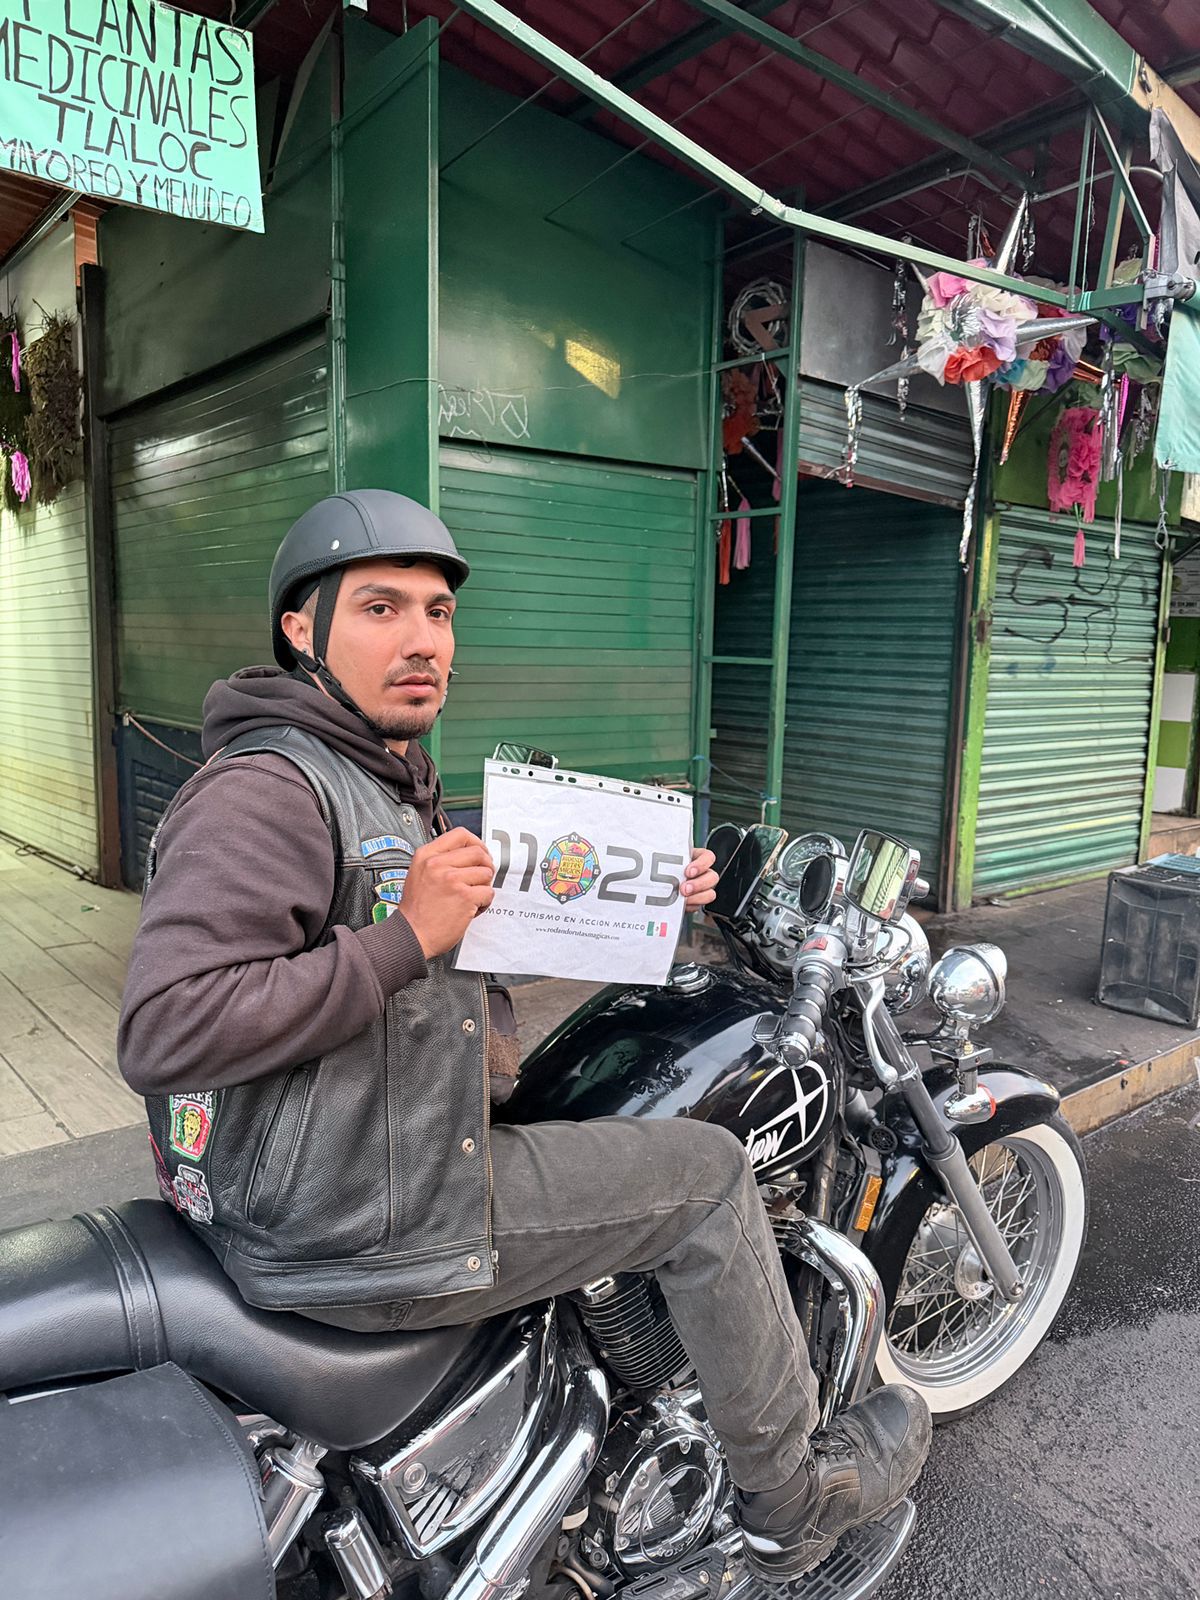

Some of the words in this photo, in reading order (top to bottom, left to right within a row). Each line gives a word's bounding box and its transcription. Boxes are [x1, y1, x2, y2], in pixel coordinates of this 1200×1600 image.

[38, 93, 213, 181] TLALOC
[129, 169, 148, 204] Y
[154, 174, 252, 228] MENUDEO
[597, 845, 684, 907] 25
[486, 908, 514, 917] MOTO
[519, 911, 561, 921] TURISMO
